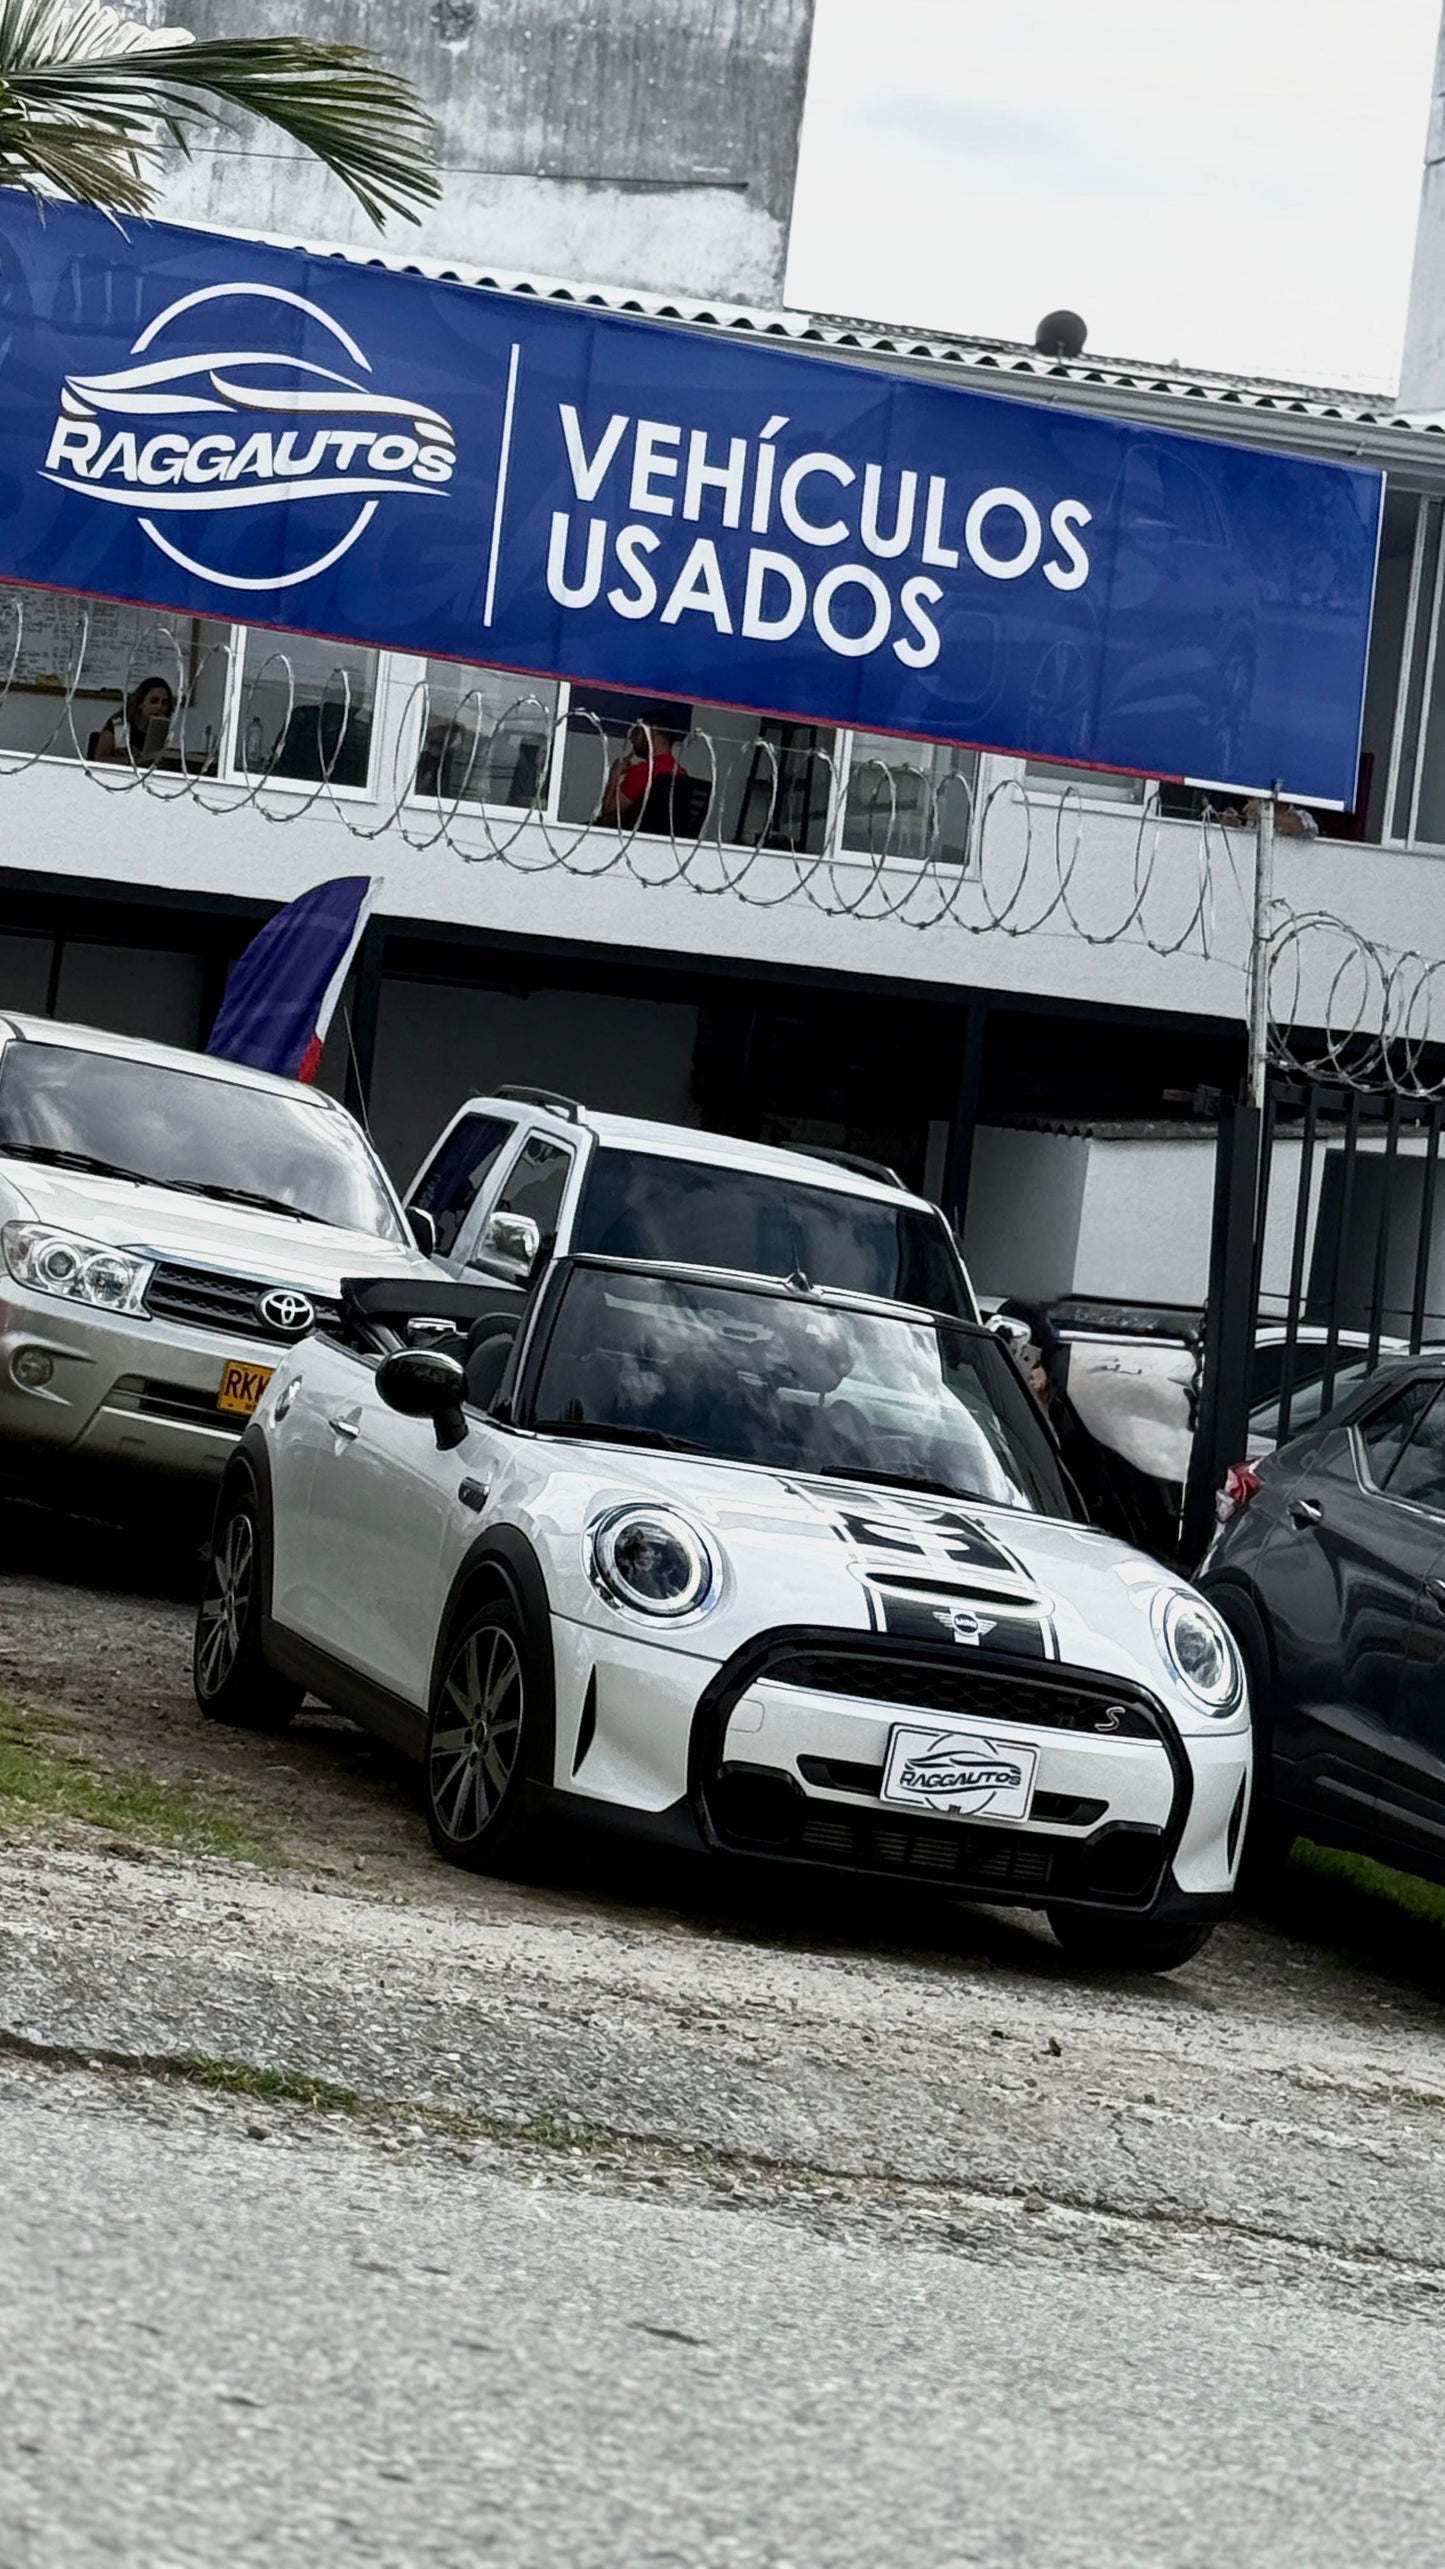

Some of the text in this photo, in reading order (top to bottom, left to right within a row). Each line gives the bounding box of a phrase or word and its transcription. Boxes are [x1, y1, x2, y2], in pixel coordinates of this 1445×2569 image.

[45, 416, 457, 485] RAGGAUTOS
[558, 403, 1092, 591] VEHÍCULOS
[546, 511, 944, 668] USADOS
[1094, 1706, 1126, 1732] S
[899, 1770, 1022, 1787] RAGGAUTOS
